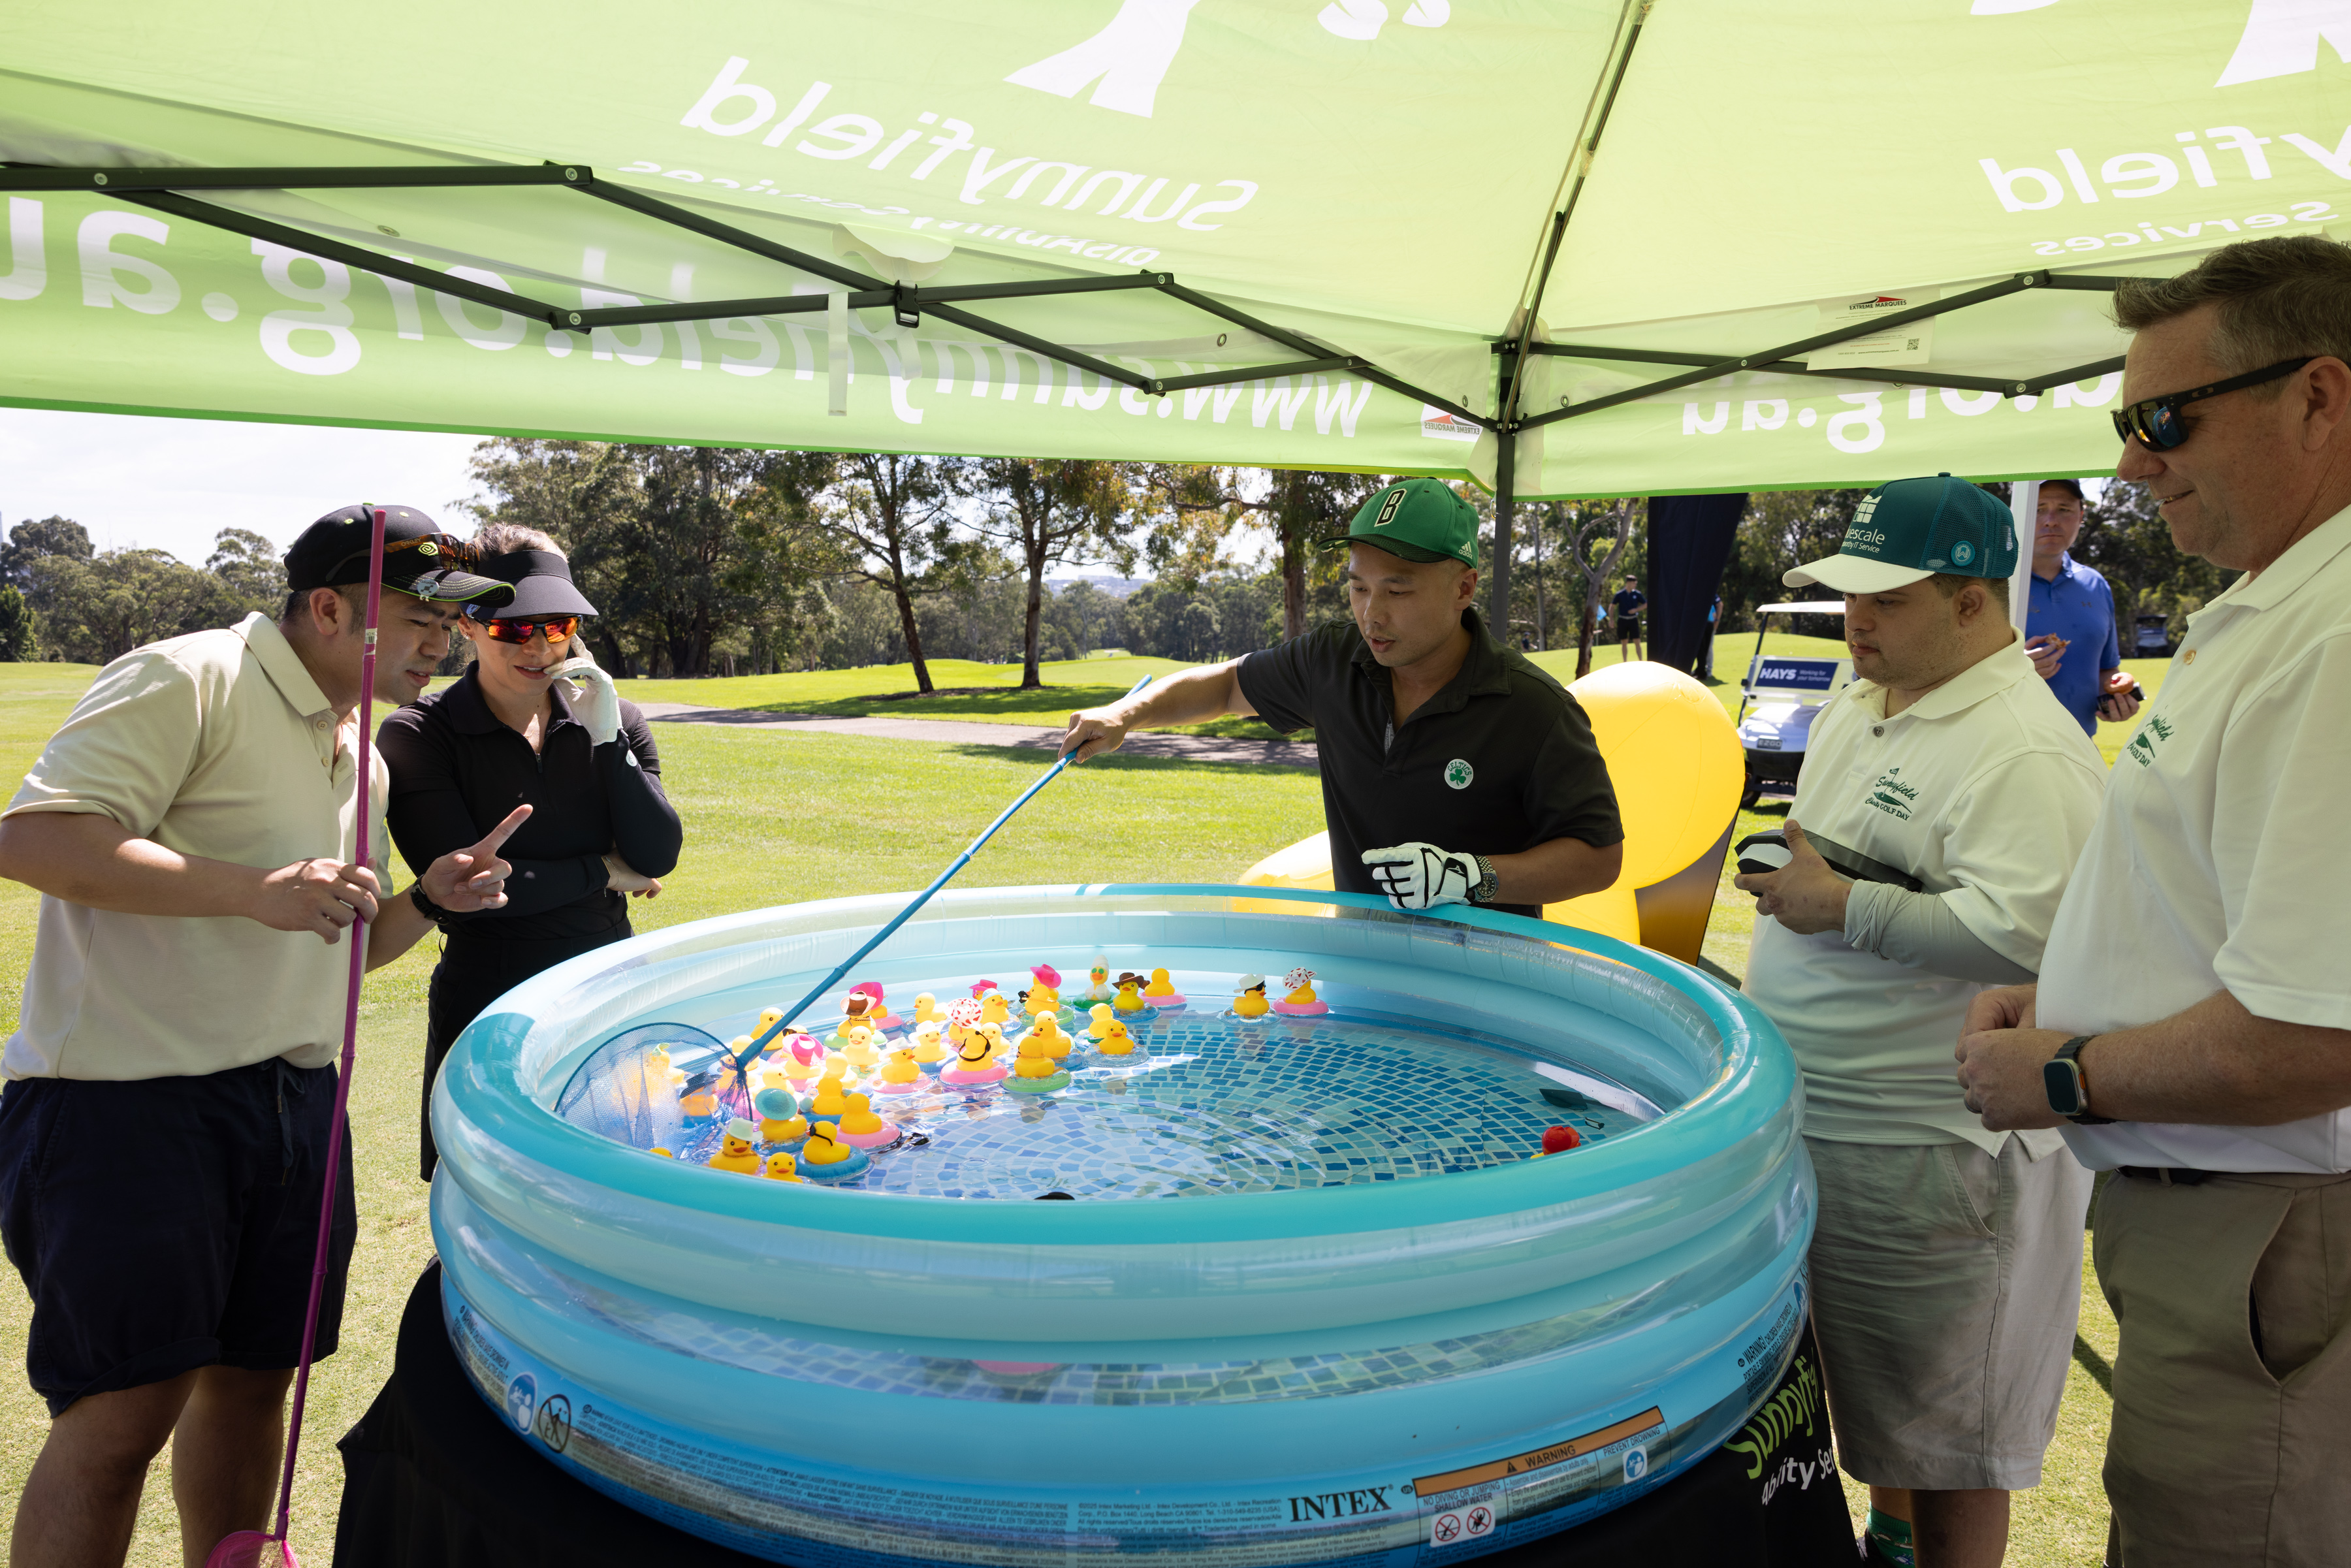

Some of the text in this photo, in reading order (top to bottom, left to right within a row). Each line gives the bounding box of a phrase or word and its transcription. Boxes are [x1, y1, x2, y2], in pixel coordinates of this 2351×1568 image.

[1875, 300, 1907, 308] MARQUEES
[1374, 488, 1407, 527] B
[1858, 542, 1880, 554] Service
[1759, 668, 1797, 680] HAYS
[1447, 761, 1472, 776] CELTICS
[1875, 776, 1919, 801] Sunnyfield
[1879, 804, 1897, 814] GOLF
[1895, 810, 1910, 821] DAY
[1603, 1426, 1661, 1457] PREVENT DROWNING
[1524, 1444, 1576, 1469] WARNING
[1509, 1477, 1530, 1486] Assemble
[1563, 1464, 1568, 1472] by
[1568, 1460, 1580, 1470] adults
[1423, 1482, 1501, 1507] NO DIVING OR JUMPING
[1434, 1492, 1494, 1513] SHALLOW WATER
